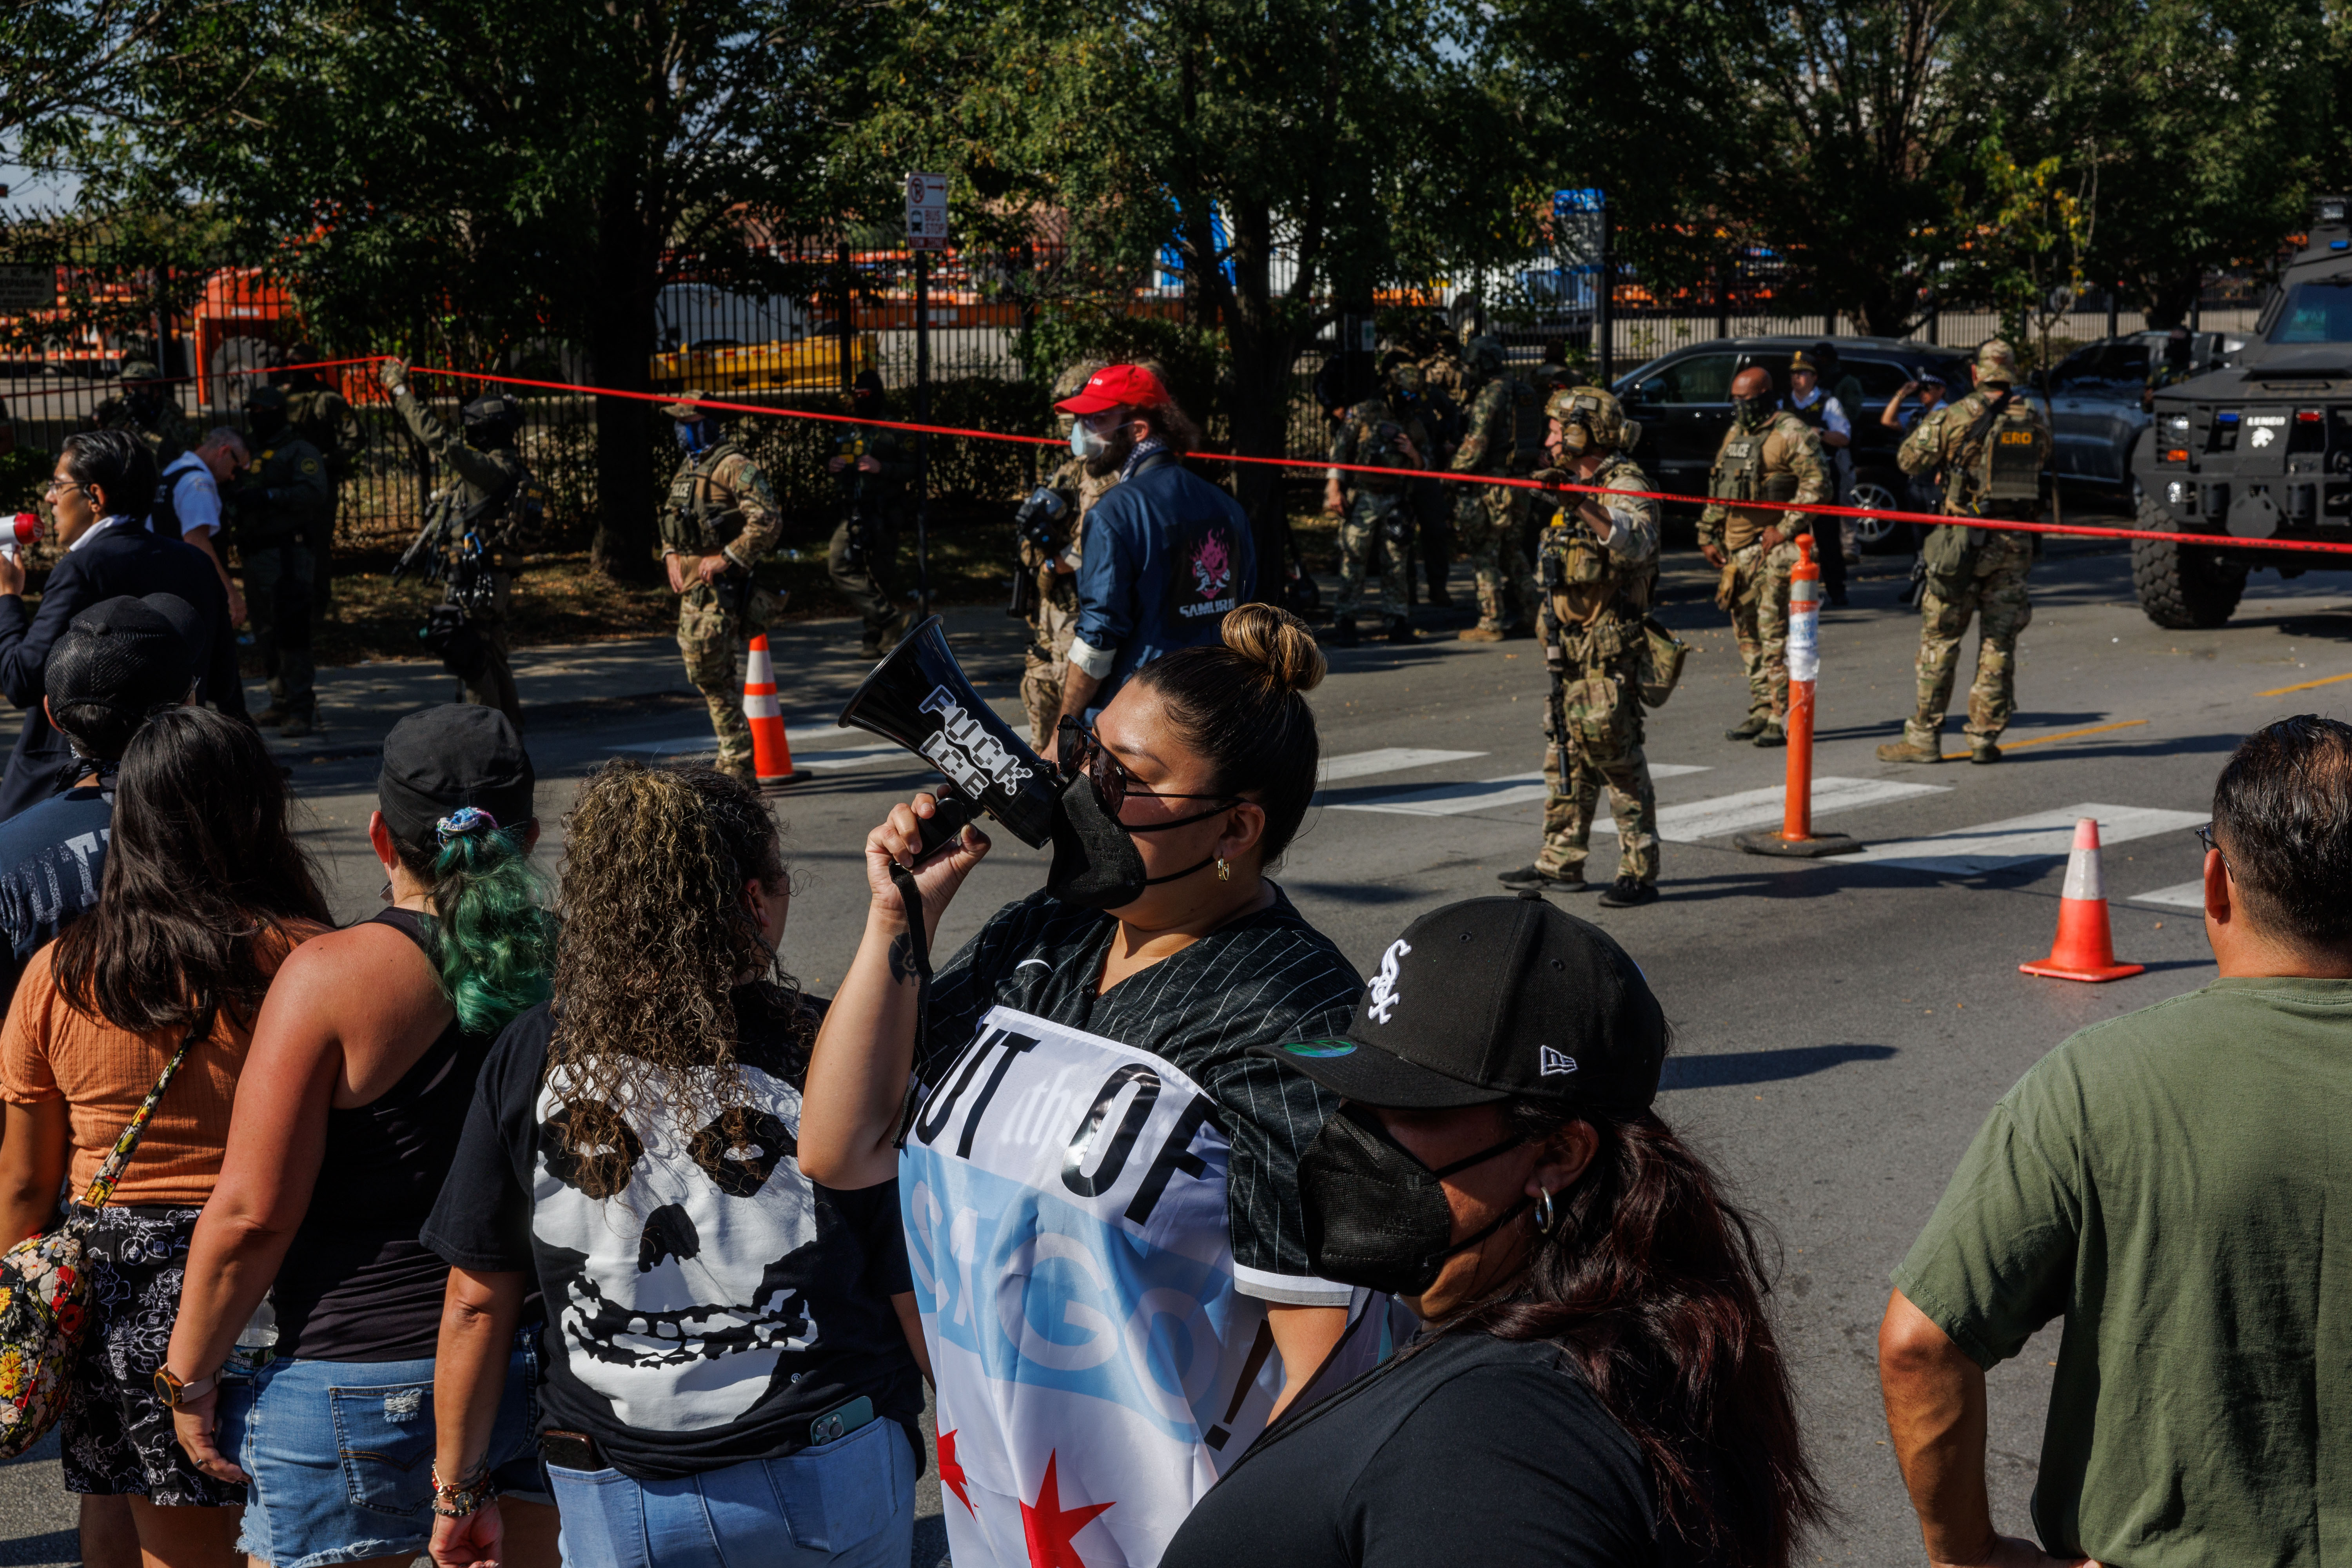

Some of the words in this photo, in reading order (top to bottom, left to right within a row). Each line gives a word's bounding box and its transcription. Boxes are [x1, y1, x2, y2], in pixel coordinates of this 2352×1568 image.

[1726, 442, 1751, 459] POLICE
[2001, 432, 2033, 445] ERO
[920, 687, 1031, 793] FUCK
[921, 733, 987, 797] ICE
[915, 1024, 1042, 1160] UT
[1061, 1063, 1230, 1226] OF
[227, 1355, 251, 1368] OUNTAIN
